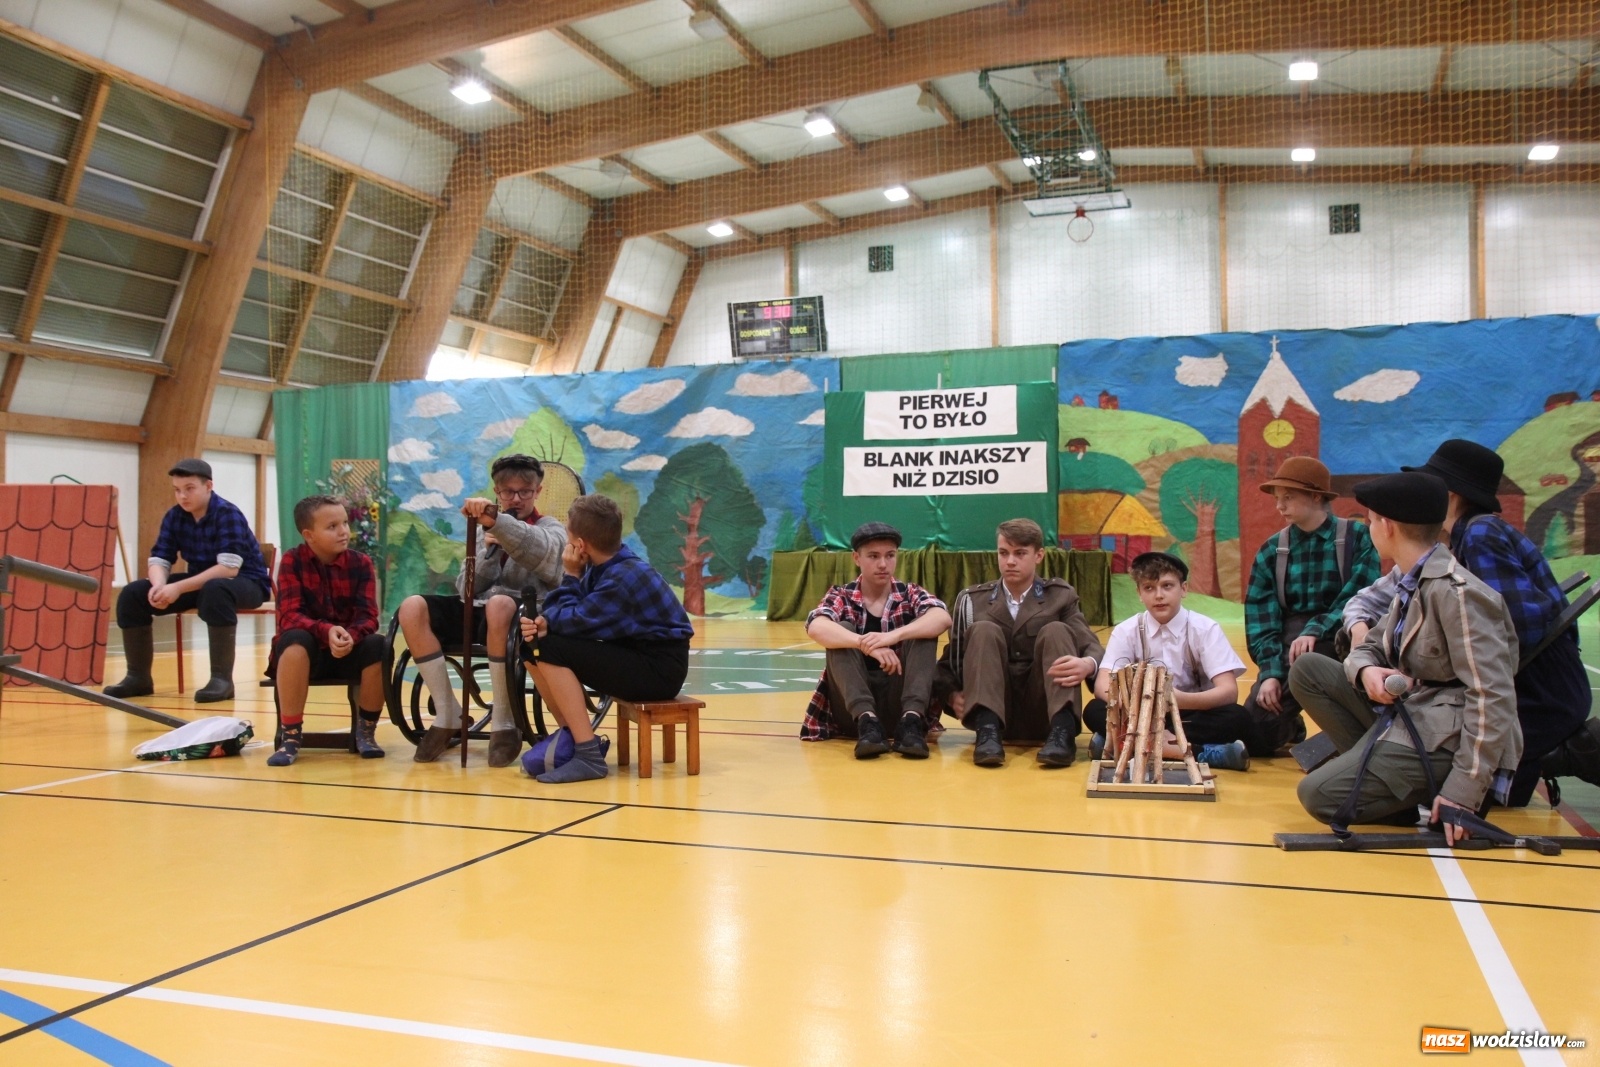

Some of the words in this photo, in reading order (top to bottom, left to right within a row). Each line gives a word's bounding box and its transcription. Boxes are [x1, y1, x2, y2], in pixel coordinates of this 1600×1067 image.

[899, 391, 988, 411] PIERWEJ
[899, 414, 928, 430] TO
[933, 410, 987, 428] BYŁO
[863, 451, 934, 468] BLANK
[939, 446, 1032, 466] INAKSZY
[893, 469, 927, 488] NIŻ
[932, 468, 999, 487] DZISIO
